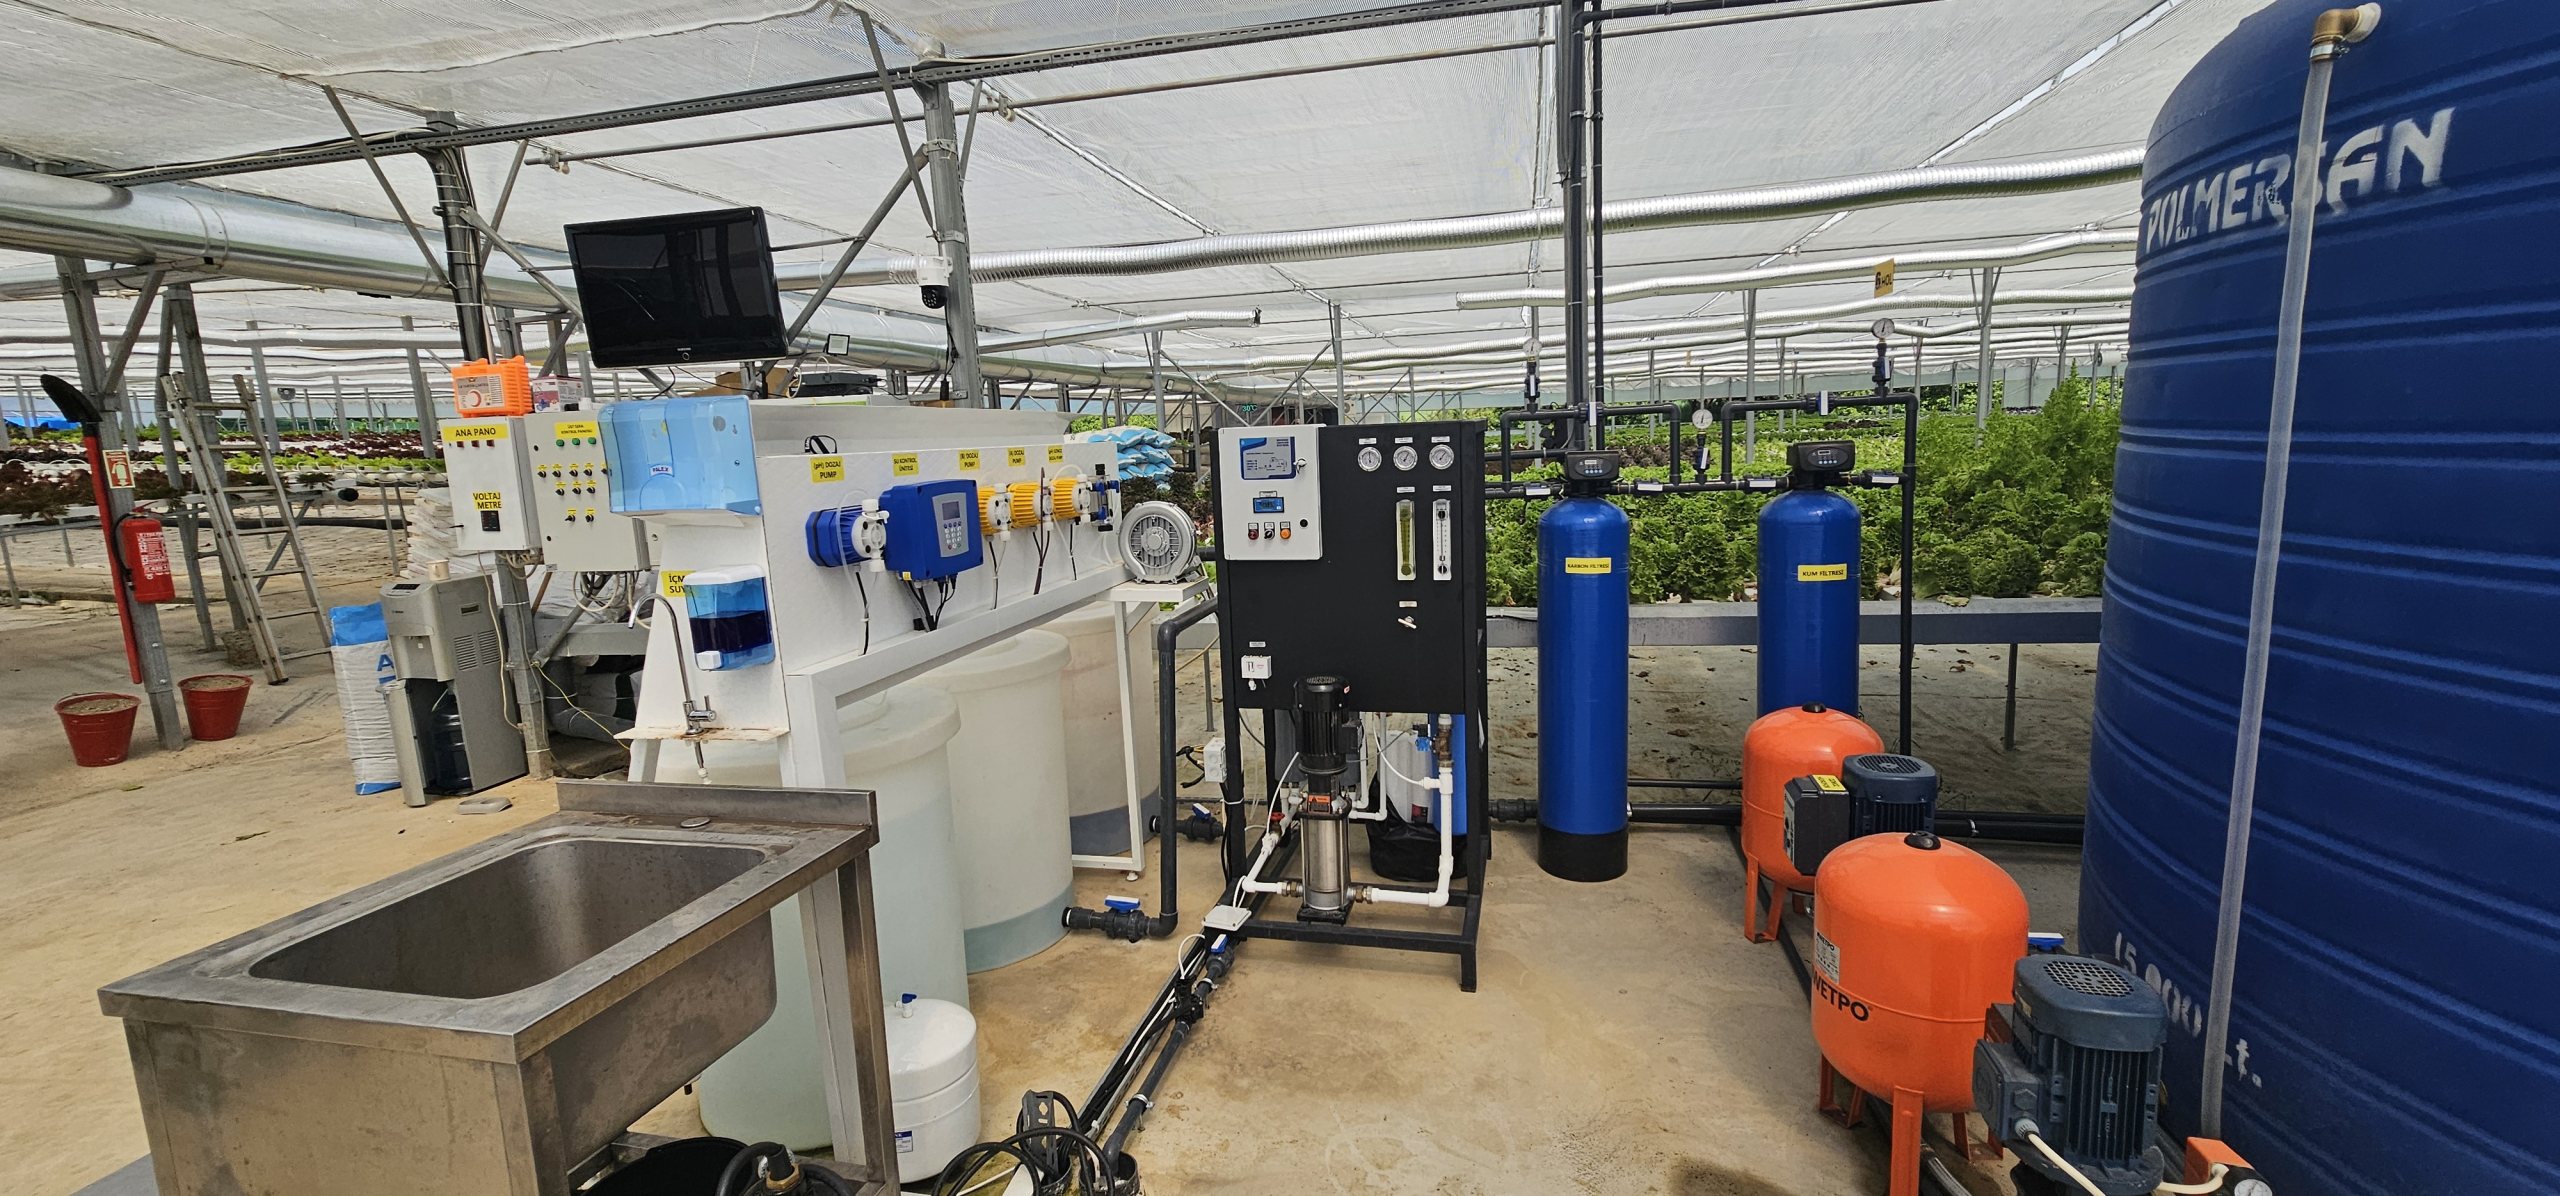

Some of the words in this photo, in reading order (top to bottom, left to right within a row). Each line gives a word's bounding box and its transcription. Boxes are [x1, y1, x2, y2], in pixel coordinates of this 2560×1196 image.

[455, 426, 473, 437] ANA
[474, 426, 497, 436] PANO
[825, 460, 841, 468] DOZAJ
[820, 471, 837, 479] PUMP
[472, 491, 501, 500] VOLTAJ
[477, 501, 502, 509] METRE
[669, 573, 686, 585] İÇM
